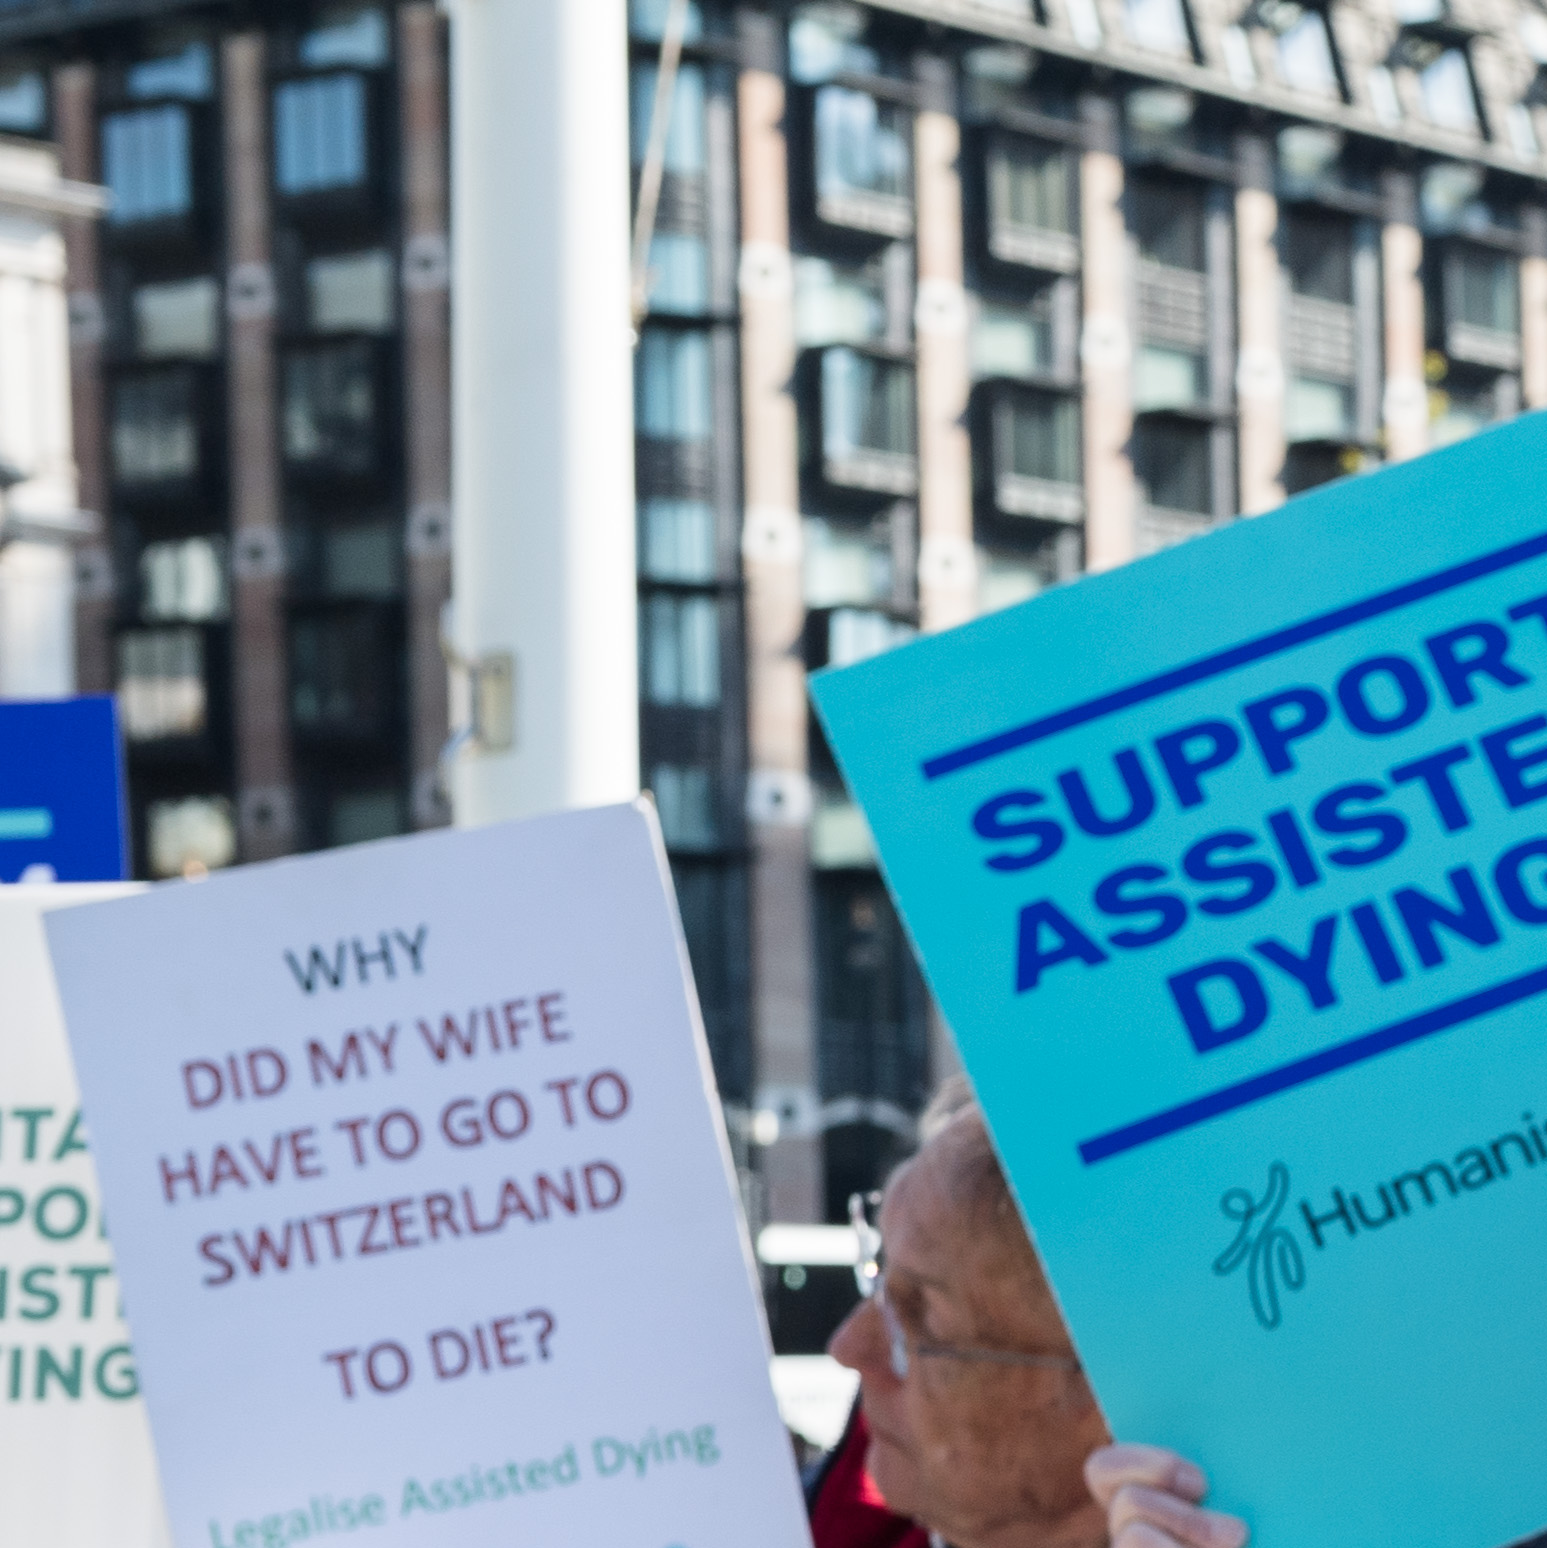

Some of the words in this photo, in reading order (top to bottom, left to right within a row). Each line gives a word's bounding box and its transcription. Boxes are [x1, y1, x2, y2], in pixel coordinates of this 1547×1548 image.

[284, 923, 428, 995] WHY
[181, 1045, 289, 1111] DID
[306, 1022, 398, 1086] MY
[416, 991, 571, 1064] WIFE
[158, 1126, 323, 1202] HAVE
[336, 1108, 422, 1168] TO
[439, 1089, 532, 1149] GO
[546, 1067, 632, 1128] TO
[0, 1186, 107, 1240] PO
[199, 1158, 627, 1288] SWITZERLAND
[0, 1266, 126, 1322] IST
[0, 1345, 142, 1401] ING
[324, 1339, 411, 1400] TO
[428, 1307, 558, 1384] DIE?
[400, 1442, 581, 1518] Assisted
[591, 1424, 722, 1480] Dying
